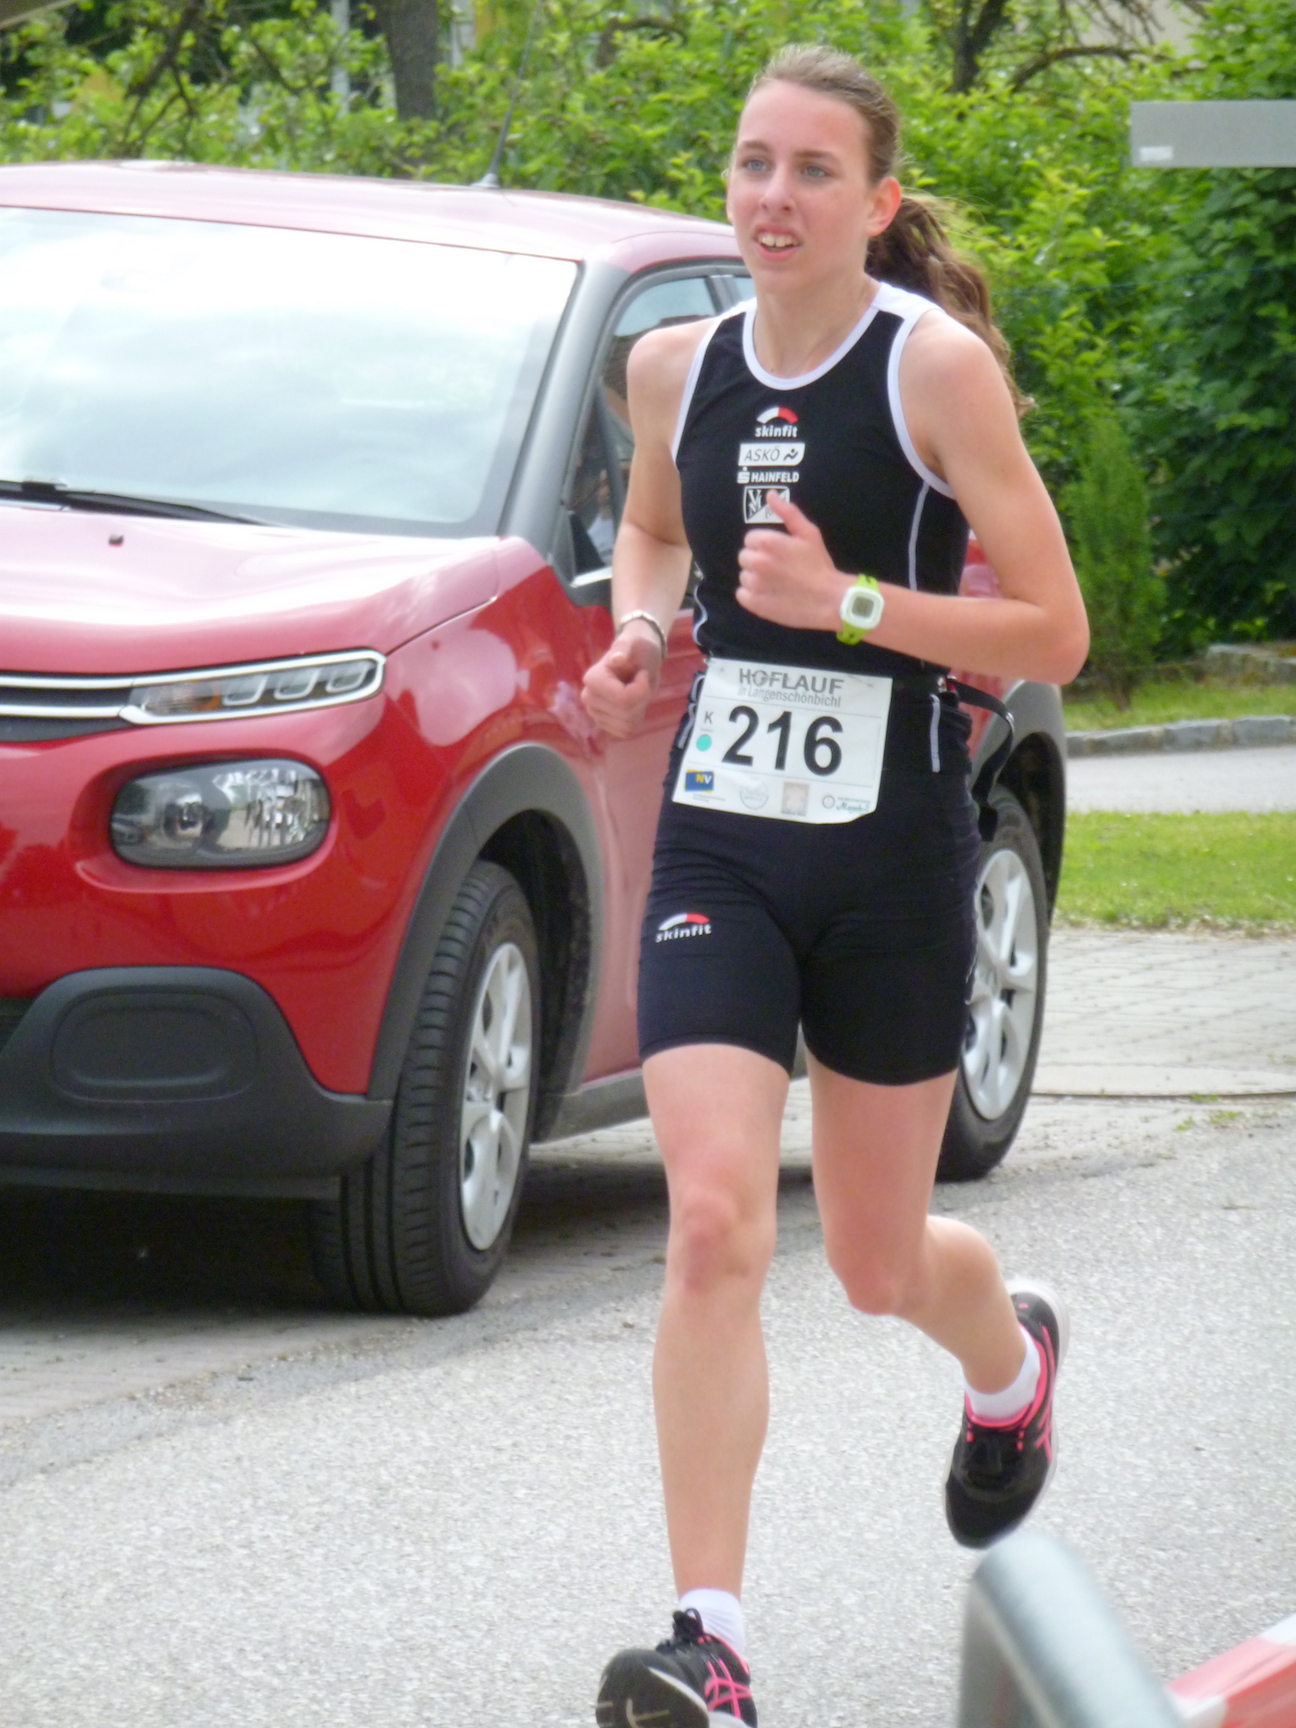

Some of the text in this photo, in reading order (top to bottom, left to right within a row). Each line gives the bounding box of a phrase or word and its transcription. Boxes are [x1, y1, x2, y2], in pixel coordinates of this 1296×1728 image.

[755, 425, 798, 437] skinfit
[744, 446, 780, 462] ASKÖ
[739, 668, 845, 695] HOFLAUF
[704, 711, 714, 725] K
[721, 705, 844, 777] 216
[655, 923, 712, 943] skinfit
